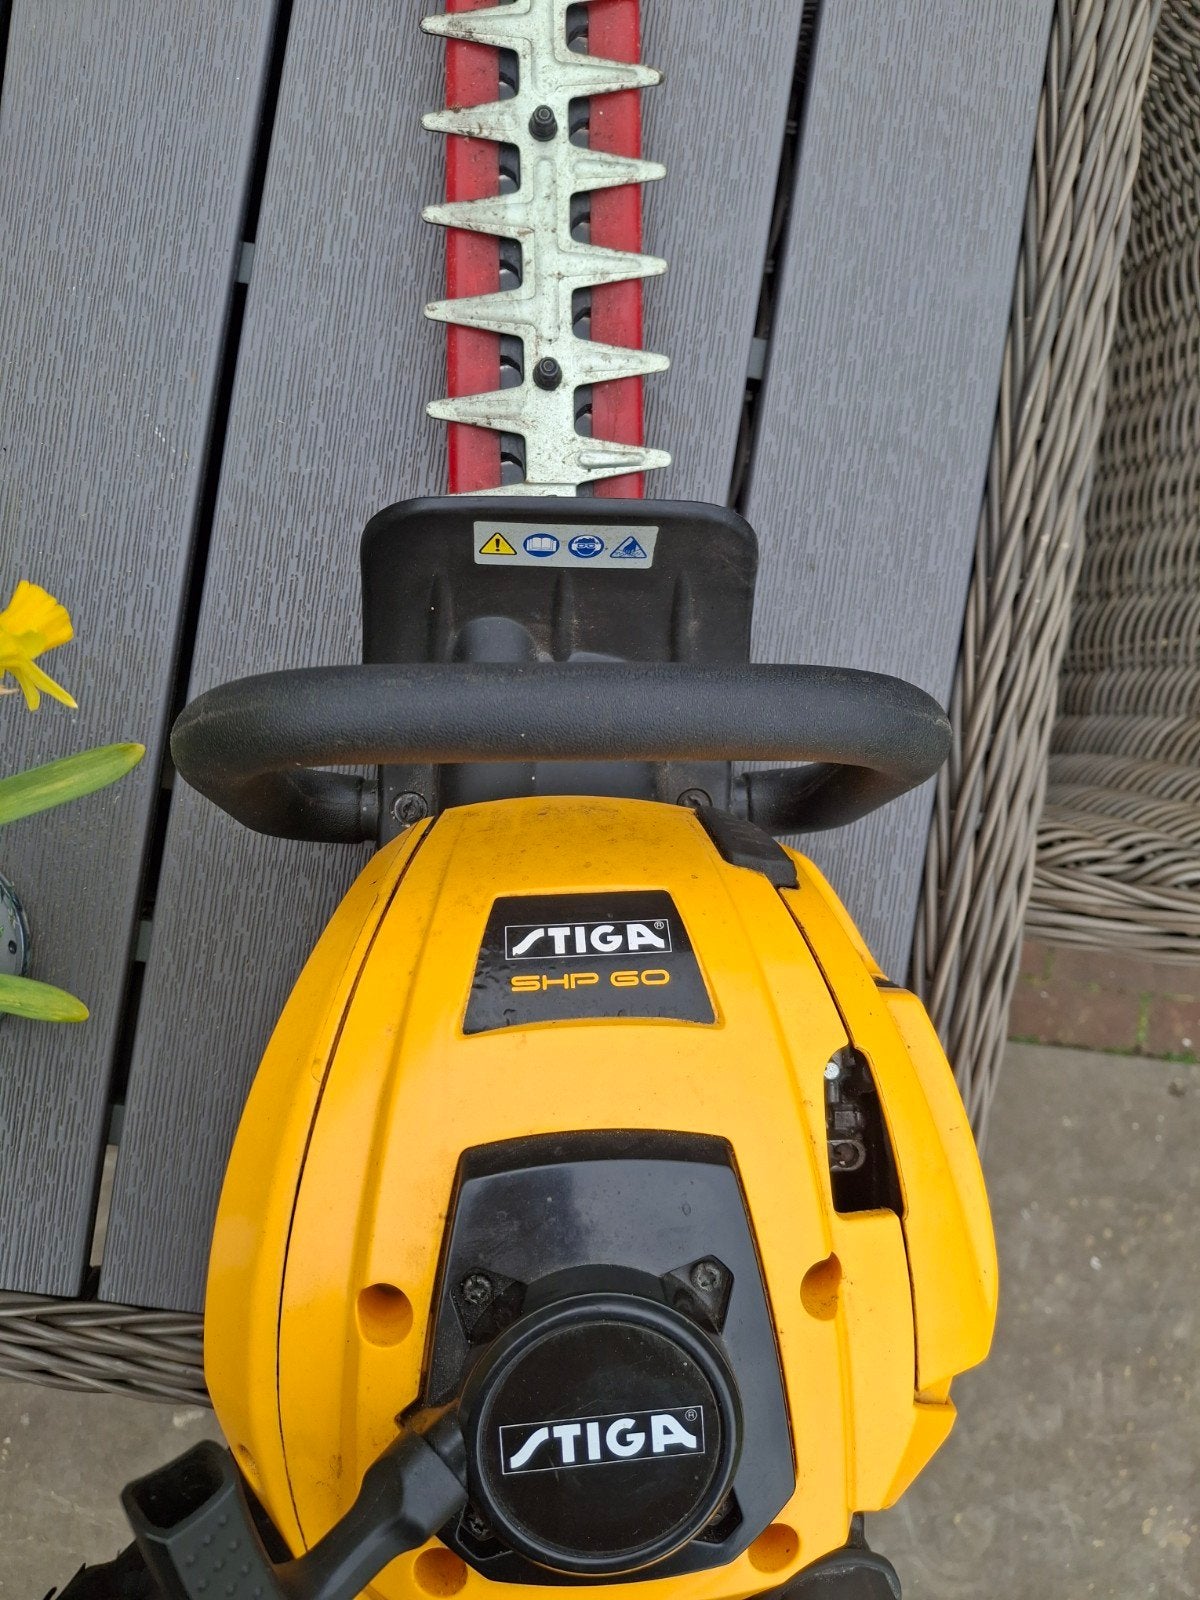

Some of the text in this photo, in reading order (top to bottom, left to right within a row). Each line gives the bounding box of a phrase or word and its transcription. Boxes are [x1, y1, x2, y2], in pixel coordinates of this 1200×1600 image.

[512, 923, 665, 957] STIGA
[510, 969, 670, 992] SHP 60
[510, 1414, 697, 1469] STIGA
